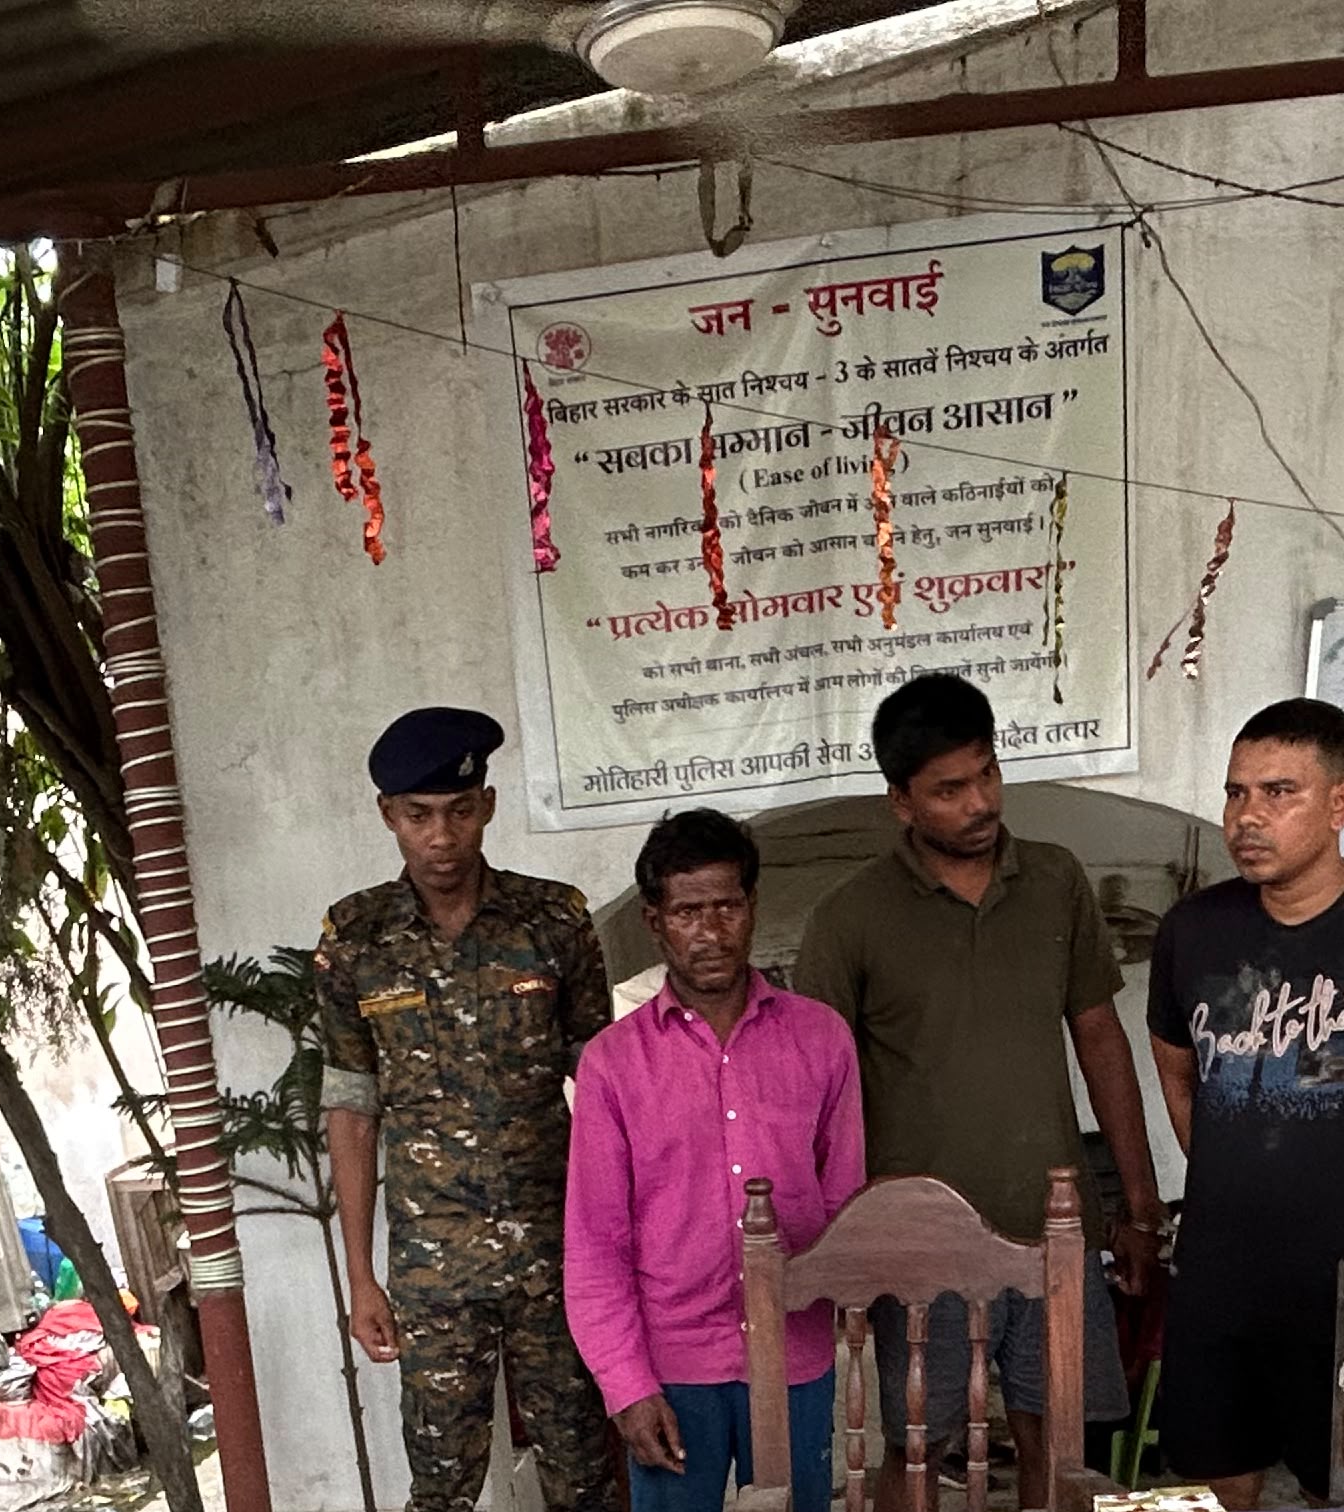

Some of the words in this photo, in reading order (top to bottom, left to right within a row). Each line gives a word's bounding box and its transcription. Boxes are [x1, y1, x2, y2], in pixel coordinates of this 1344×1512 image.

[688, 299, 754, 336] जन
[804, 258, 945, 337] सुनवाई
[546, 398, 598, 425] बिहार
[603, 388, 666, 416] सरकार
[670, 380, 692, 408] के
[696, 382, 737, 404] सात
[741, 369, 810, 399] निश्चय
[834, 360, 849, 384] 3
[855, 355, 877, 382] के
[882, 346, 940, 380] सातवें
[945, 344, 1014, 374] निश्चय
[1017, 336, 1041, 363] के
[1043, 329, 1110, 361] अंतर्गत
[840, 400, 936, 442] जीवन
[810, 457, 832, 481] of
[604, 523, 640, 545] सभी
[719, 509, 742, 530] को
[800, 499, 843, 520] जीवन
[846, 492, 858, 513] में
[901, 485, 937, 508] वाले
[941, 475, 1025, 503] कठिनाईयों
[1031, 473, 1056, 494] को
[620, 562, 651, 580] कम
[655, 560, 680, 577] कर
[729, 545, 777, 568] जीवन
[782, 538, 804, 560] को
[809, 533, 857, 555] आसान
[945, 520, 972, 540] जन
[850, 570, 906, 618] एवं
[642, 659, 665, 681] को
[669, 655, 702, 678] सभी
[749, 647, 781, 668] सभी
[830, 634, 863, 655] सभी
[935, 622, 1004, 645] कार्यालय
[612, 698, 658, 725] पुलिस
[723, 680, 795, 706] कार्यालय
[797, 674, 812, 695] में
[813, 673, 844, 693] आम
[846, 667, 884, 689] लोगों
[885, 664, 907, 686] की
[583, 760, 669, 795] मोतिहारी
[672, 754, 734, 792] पुलिस
[740, 741, 810, 777] आपकी
[816, 737, 853, 766] सेवा
[1044, 717, 1102, 745] तत्पर
